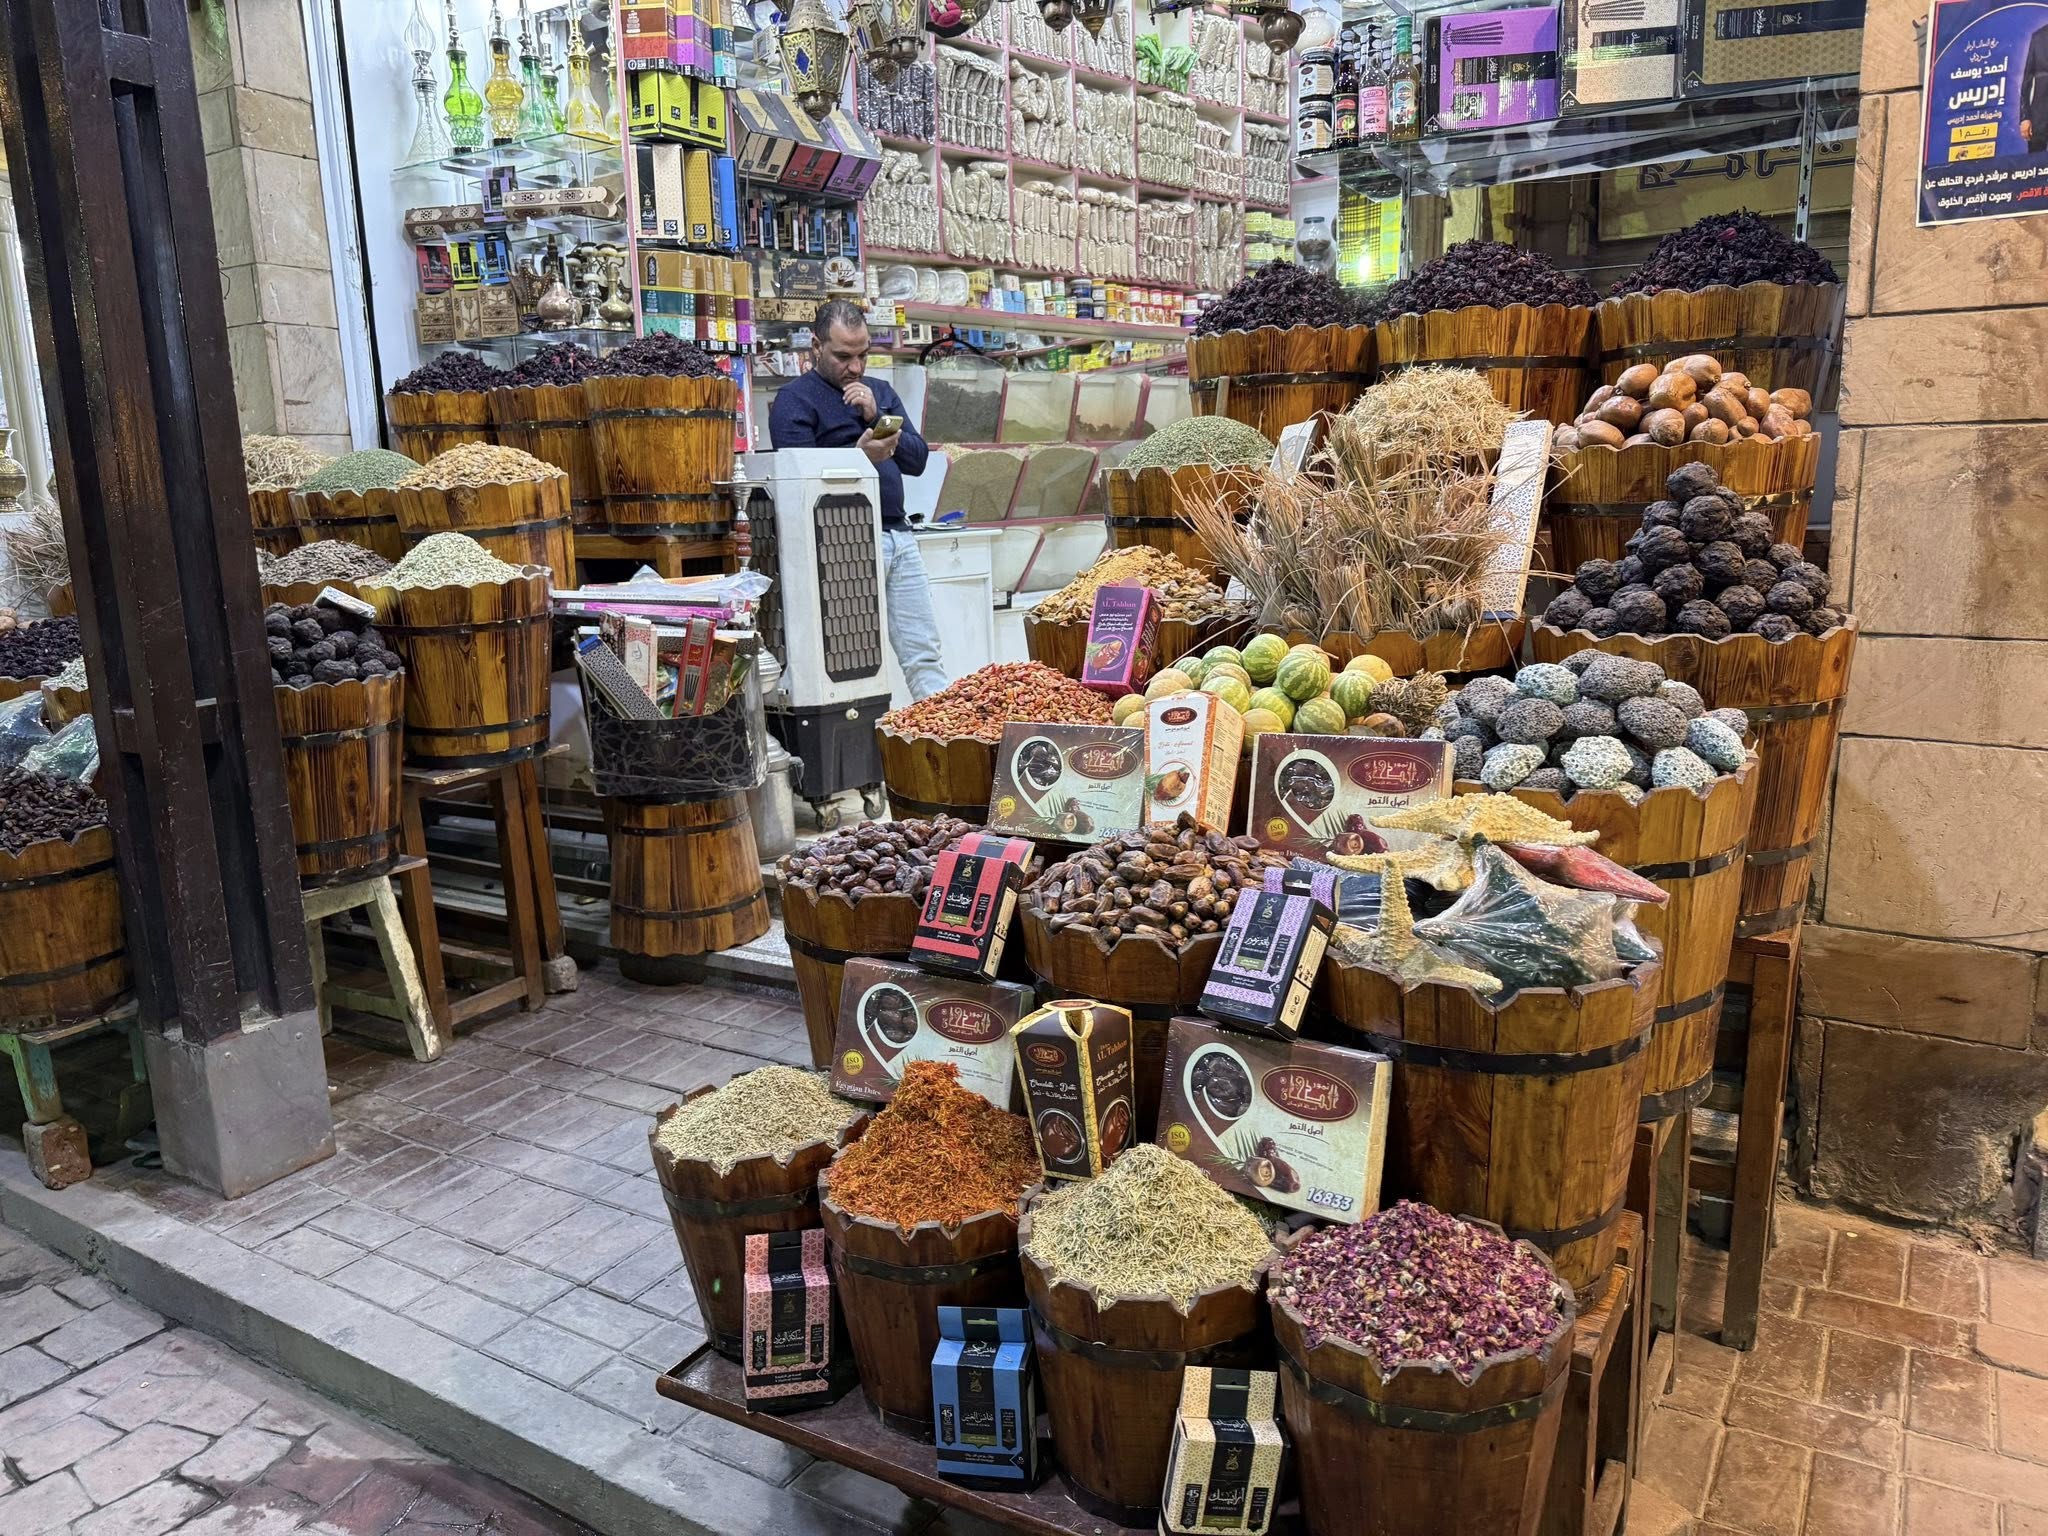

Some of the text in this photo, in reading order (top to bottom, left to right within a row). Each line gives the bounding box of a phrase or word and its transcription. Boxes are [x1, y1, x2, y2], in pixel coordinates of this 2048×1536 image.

[1950, 55, 2009, 79] أحمد يوسف
[1948, 77, 2006, 109] إدريس
[1966, 110, 1980, 121] أحمد
[1985, 169, 2009, 184] مرشح
[2011, 166, 2037, 180] إدريس
[1925, 180, 1937, 190] عن
[1937, 175, 1963, 187] التحالف
[1964, 173, 1985, 187] فردي
[1988, 191, 2012, 203] وصوت
[1367, 795, 1410, 807] أصل التمر
[964, 1047, 978, 1056] أصل
[846, 1056, 860, 1064] ISO
[1171, 1131, 1185, 1139] ISO
[1288, 1122, 1324, 1136] أصل التمر
[1306, 1186, 1354, 1212] 16833
[754, 1334, 766, 1344] 45
[941, 1409, 953, 1417] 45
[1186, 1489, 1200, 1498] 45
